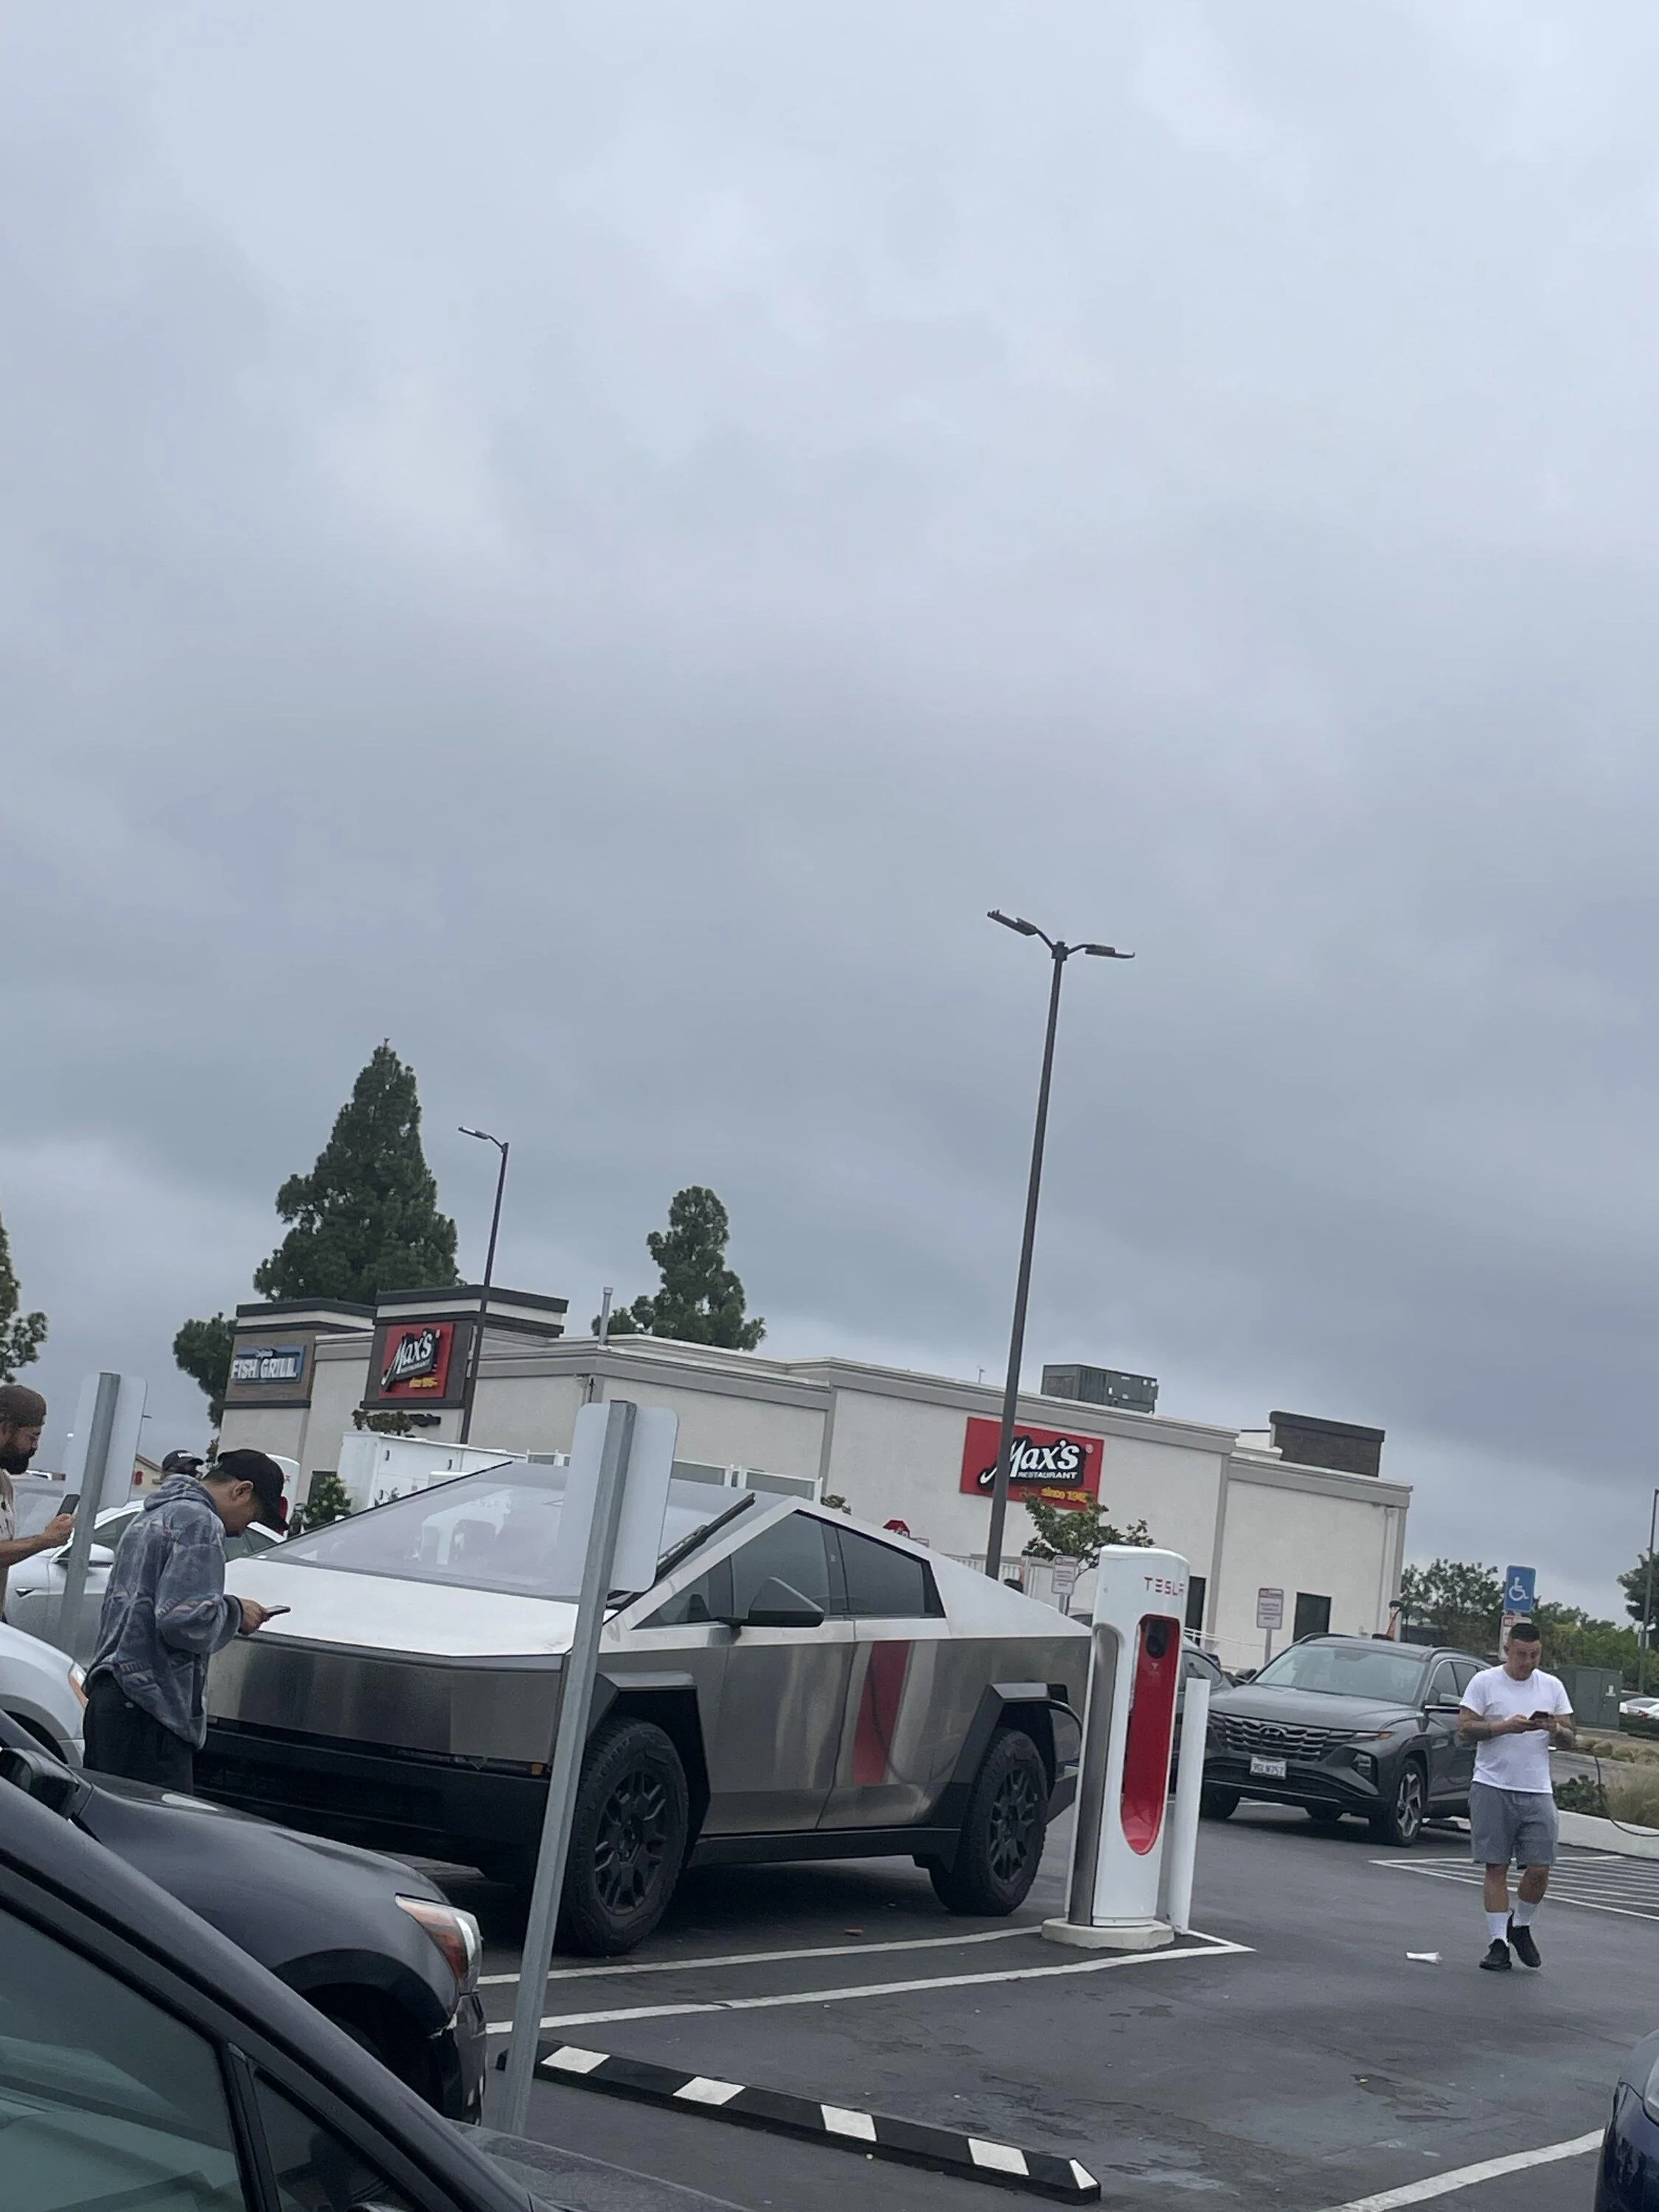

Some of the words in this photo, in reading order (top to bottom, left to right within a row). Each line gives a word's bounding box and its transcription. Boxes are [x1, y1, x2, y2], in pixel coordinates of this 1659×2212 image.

[231, 1359, 258, 1379] FISH
[260, 1357, 296, 1379] GRILL
[381, 1330, 433, 1385] Max's
[980, 1440, 1080, 1484] Max's
[1018, 1471, 1078, 1480] RESTAURANT
[1144, 1576, 1184, 1596] TESLA
